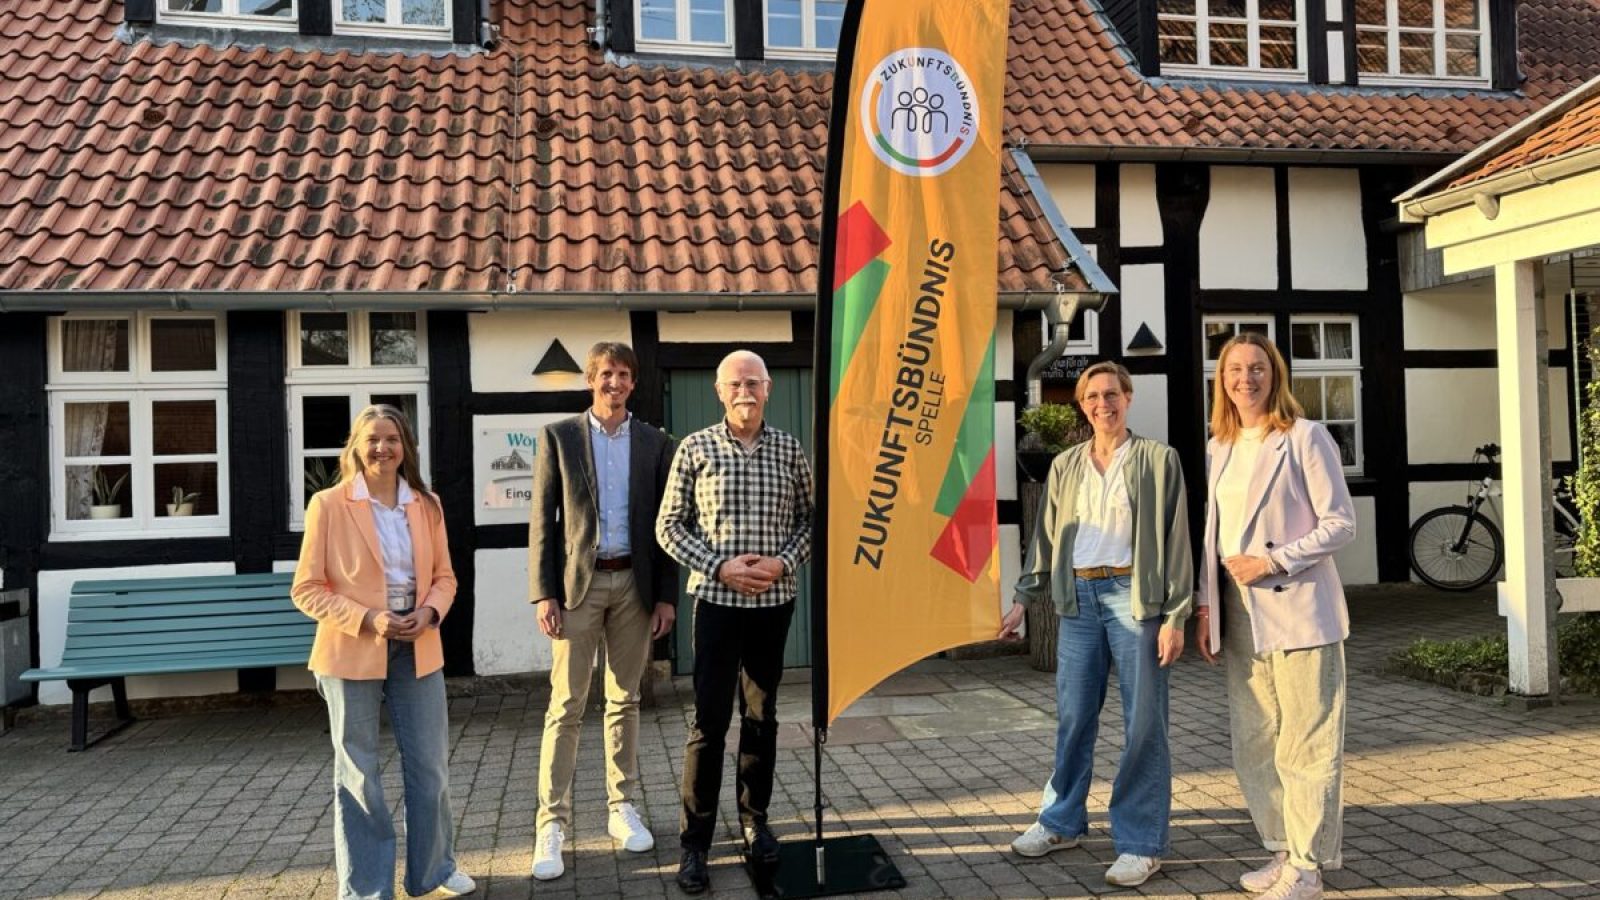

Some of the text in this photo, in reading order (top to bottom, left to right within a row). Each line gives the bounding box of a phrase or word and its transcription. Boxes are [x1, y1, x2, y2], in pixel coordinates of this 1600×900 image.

[880, 56, 973, 136] ZUKUNFTSBÜNDNIS
[853, 238, 955, 570] ZUKUNFTSBÜNDNIS
[915, 371, 946, 446] SPELLE
